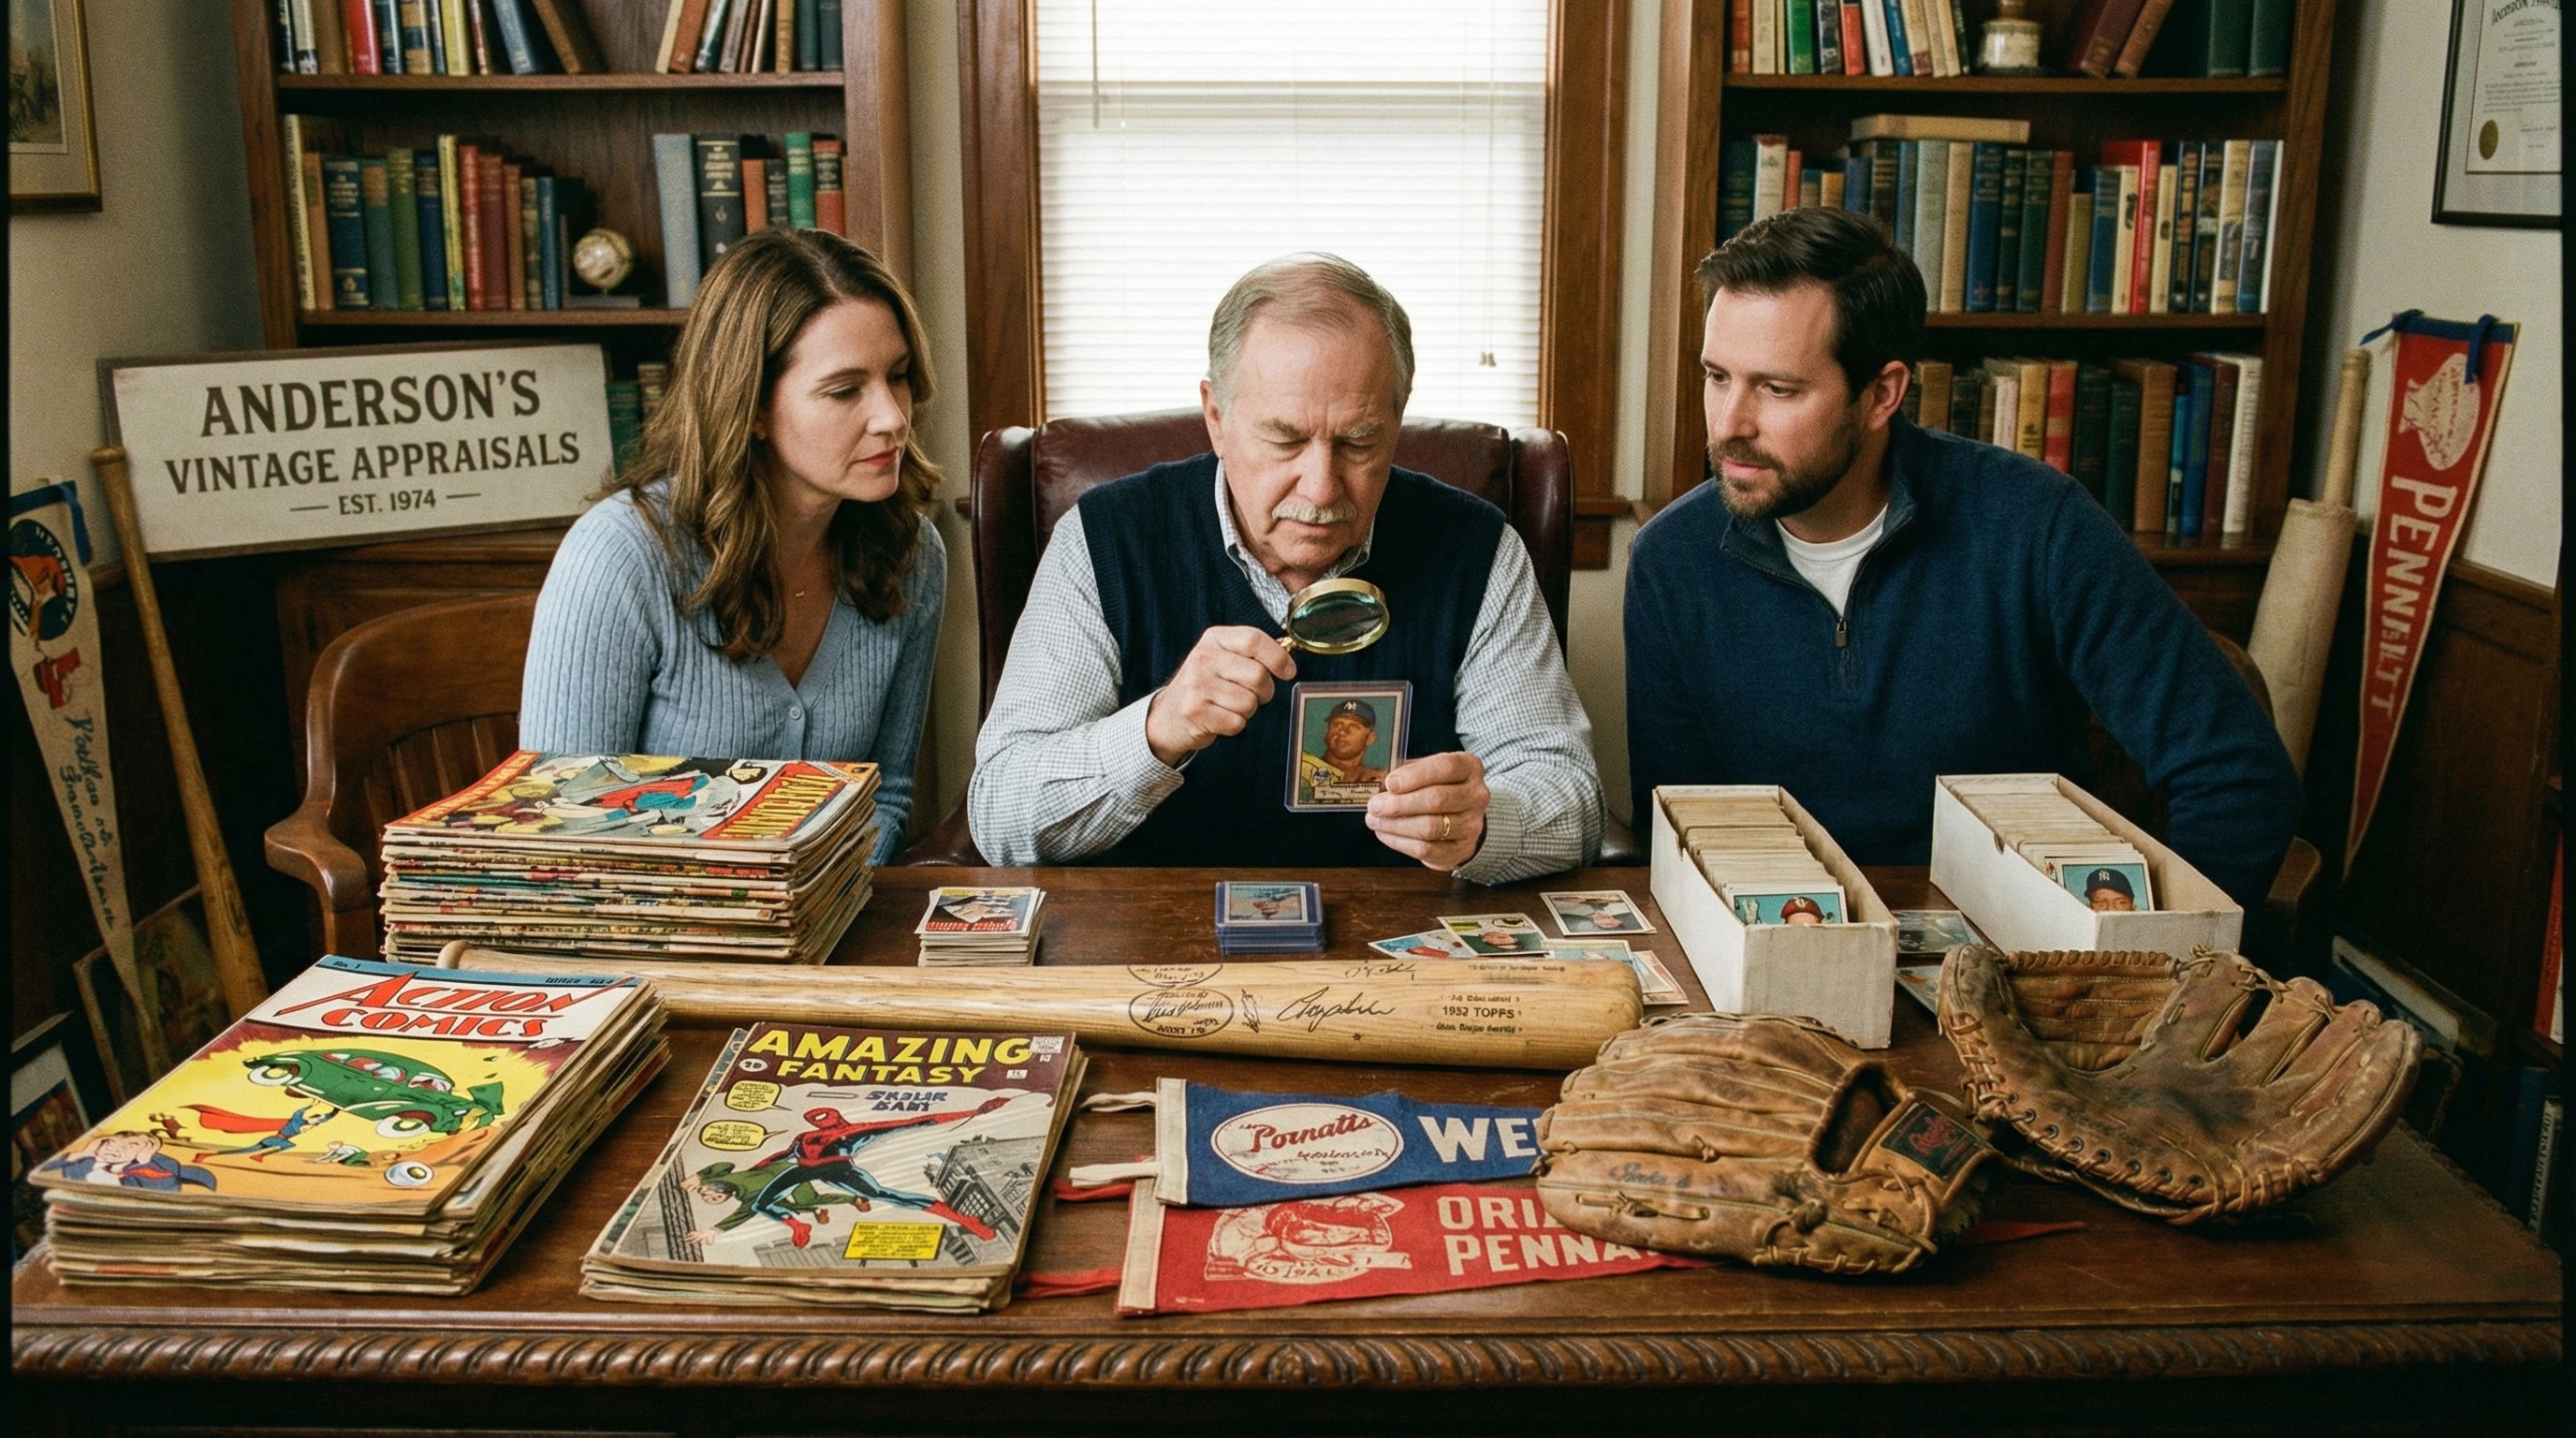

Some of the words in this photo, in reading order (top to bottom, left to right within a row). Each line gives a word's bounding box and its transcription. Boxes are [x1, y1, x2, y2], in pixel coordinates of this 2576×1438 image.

[200, 370, 540, 437] ANDERSON'S
[165, 448, 339, 494] VINTAGE
[351, 432, 580, 481] APPRAISALS
[339, 494, 383, 515] EST.
[390, 489, 436, 511] 1974
[272, 971, 635, 1017] ACTION
[321, 1008, 549, 1037] COMICS
[748, 1029, 1032, 1065] AMAZING
[776, 1061, 988, 1084] FANTASY
[1418, 1116, 1546, 1164] WE
[1444, 1234, 1661, 1276] PENNA
